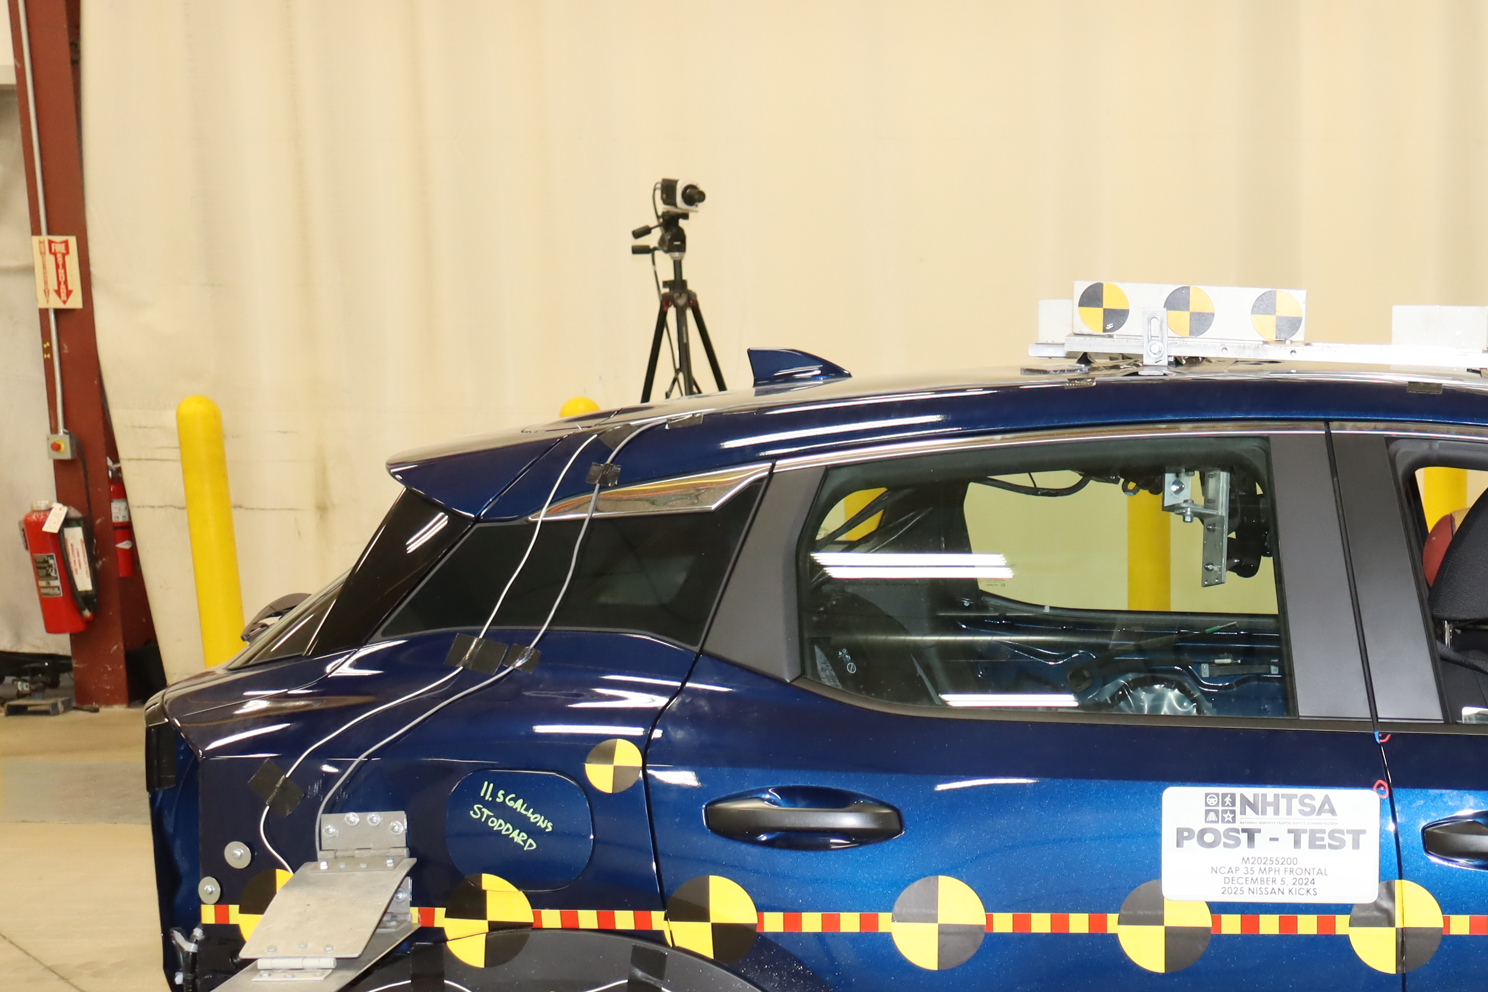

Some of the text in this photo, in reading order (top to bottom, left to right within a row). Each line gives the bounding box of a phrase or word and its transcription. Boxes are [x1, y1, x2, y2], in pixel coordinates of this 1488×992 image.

[1239, 793, 1337, 817] NHTSA
[505, 794, 554, 832] GALLONS
[470, 804, 537, 851] STODDARD
[1176, 828, 1261, 849] POST
[1288, 829, 1366, 850] TEST
[1242, 857, 1298, 865] M20255200
[1244, 867, 1255, 875] 35
[1258, 867, 1280, 875] MPH
[1284, 868, 1328, 876] FRONTAL
[1224, 877, 1277, 885] DECEMBER
[1292, 878, 1316, 886] 2024
[1221, 887, 1318, 896] 2025 NISSAN KICKS
